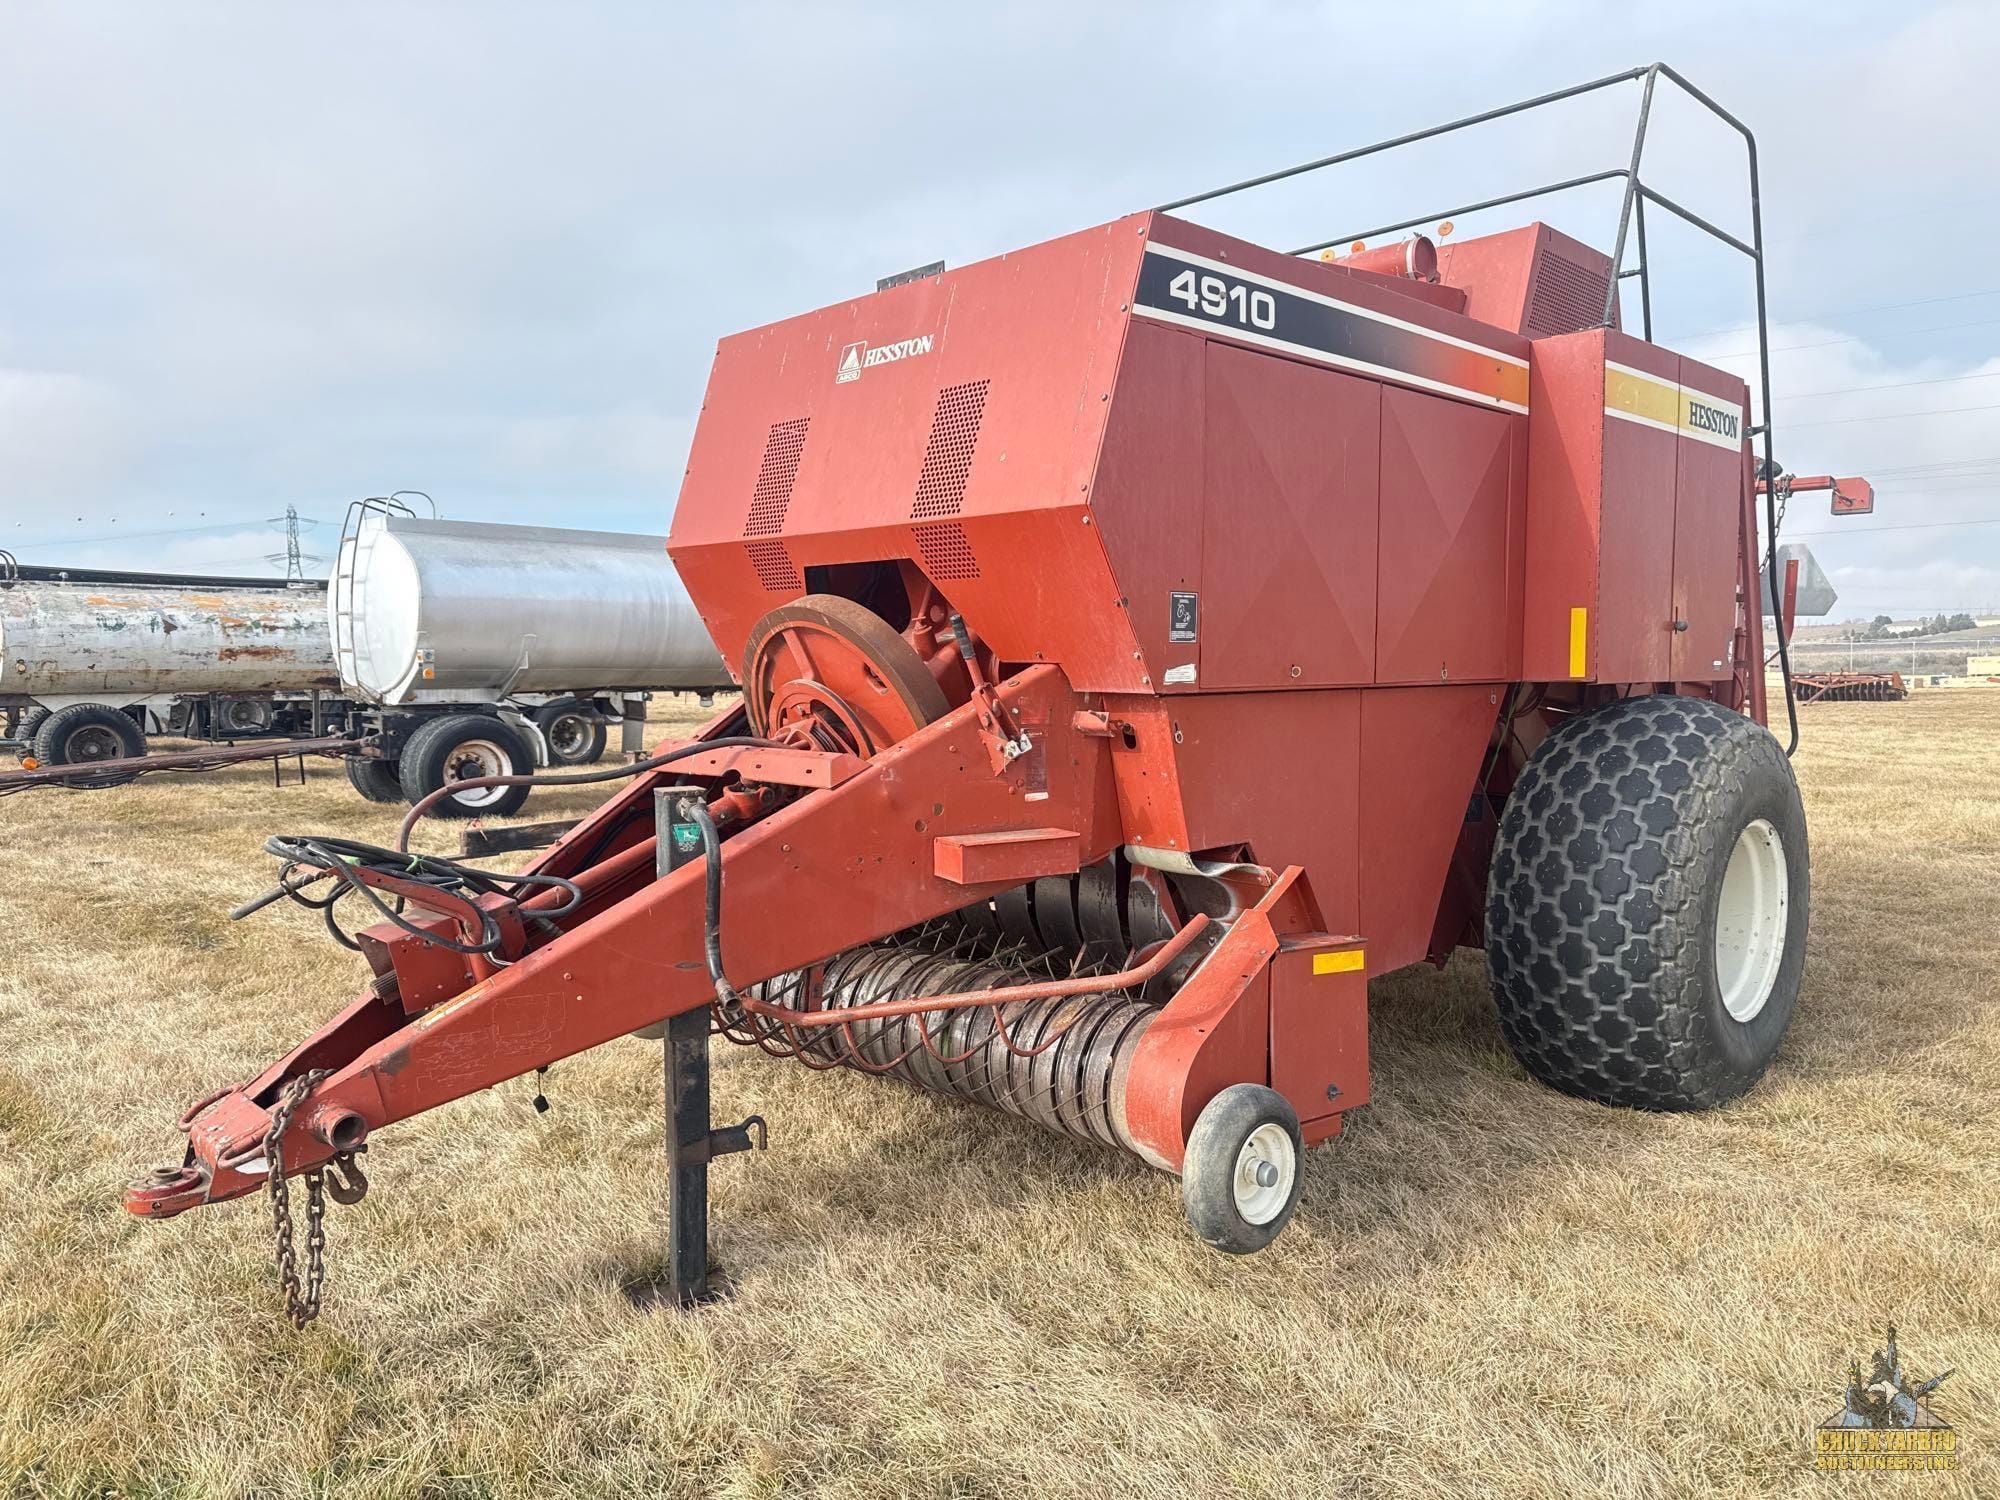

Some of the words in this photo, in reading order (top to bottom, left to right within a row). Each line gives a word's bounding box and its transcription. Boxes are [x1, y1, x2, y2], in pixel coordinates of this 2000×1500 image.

[1169, 269, 1275, 330] 4910
[863, 333, 935, 368] HESSTON
[1689, 401, 1738, 439] HESSTON
